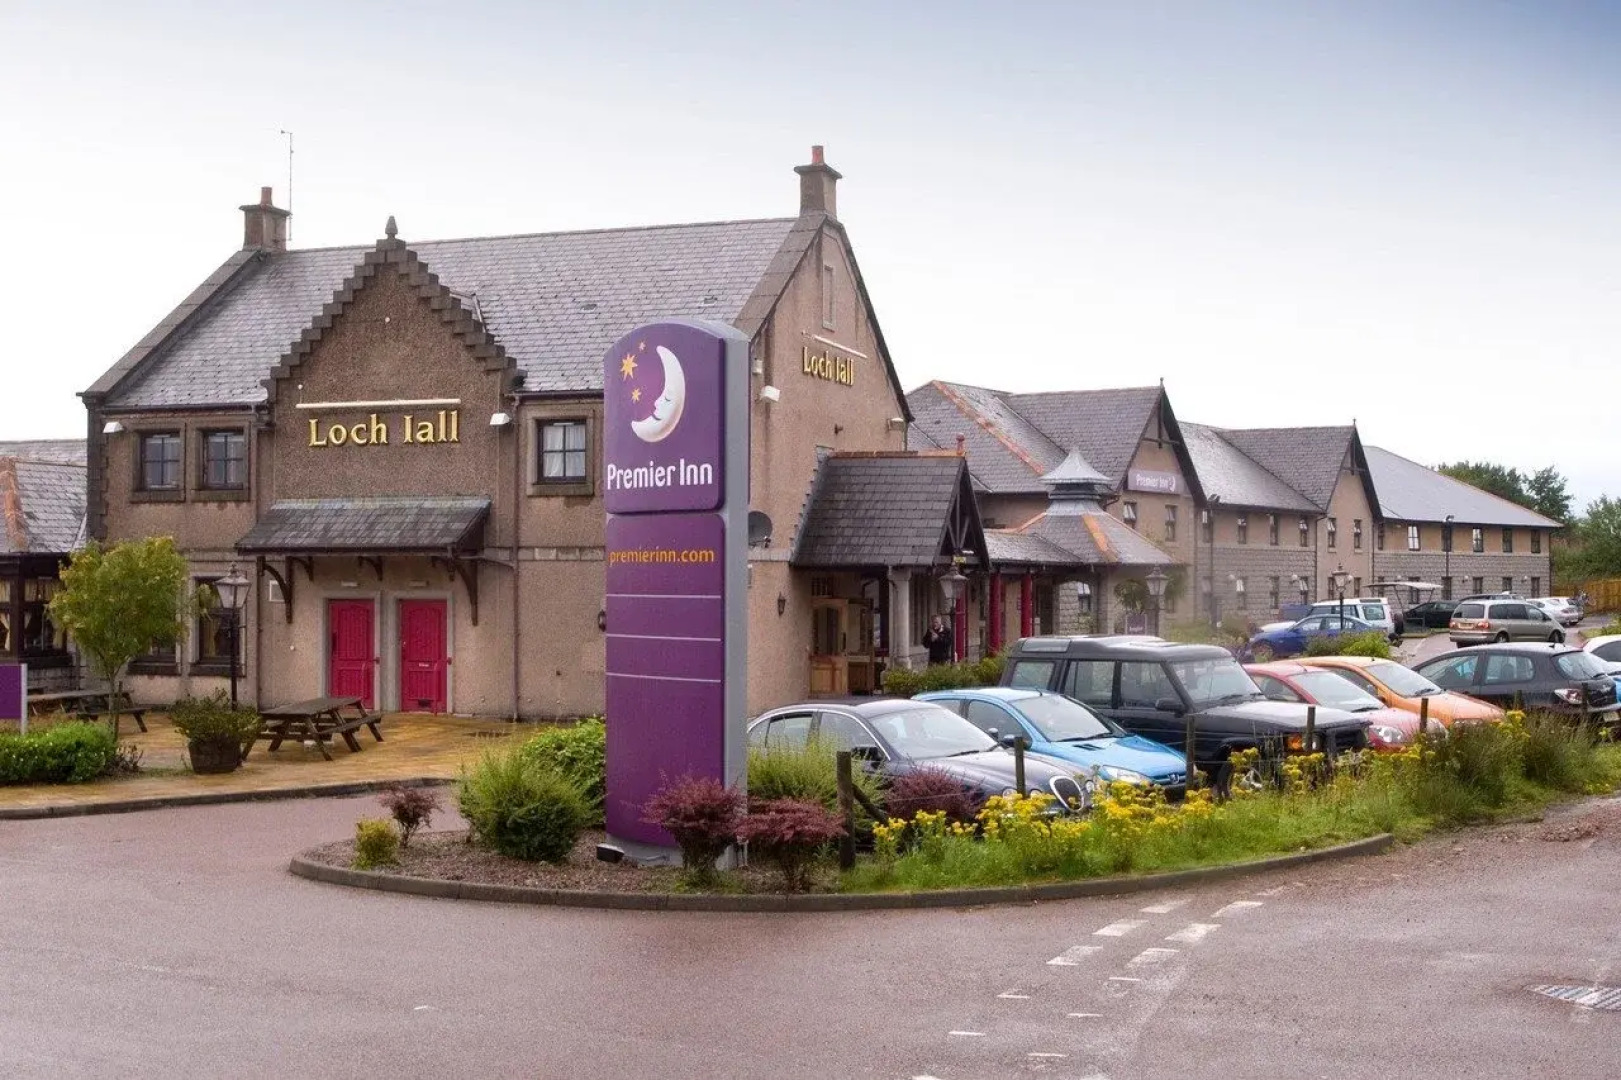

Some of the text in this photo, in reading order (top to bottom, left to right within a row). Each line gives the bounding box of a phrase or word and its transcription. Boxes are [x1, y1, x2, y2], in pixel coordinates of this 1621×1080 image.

[802, 346, 832, 379] Loch
[308, 409, 460, 447] Loch Iall
[606, 458, 713, 490] Premier Inn
[608, 545, 715, 567] premierinn.com
